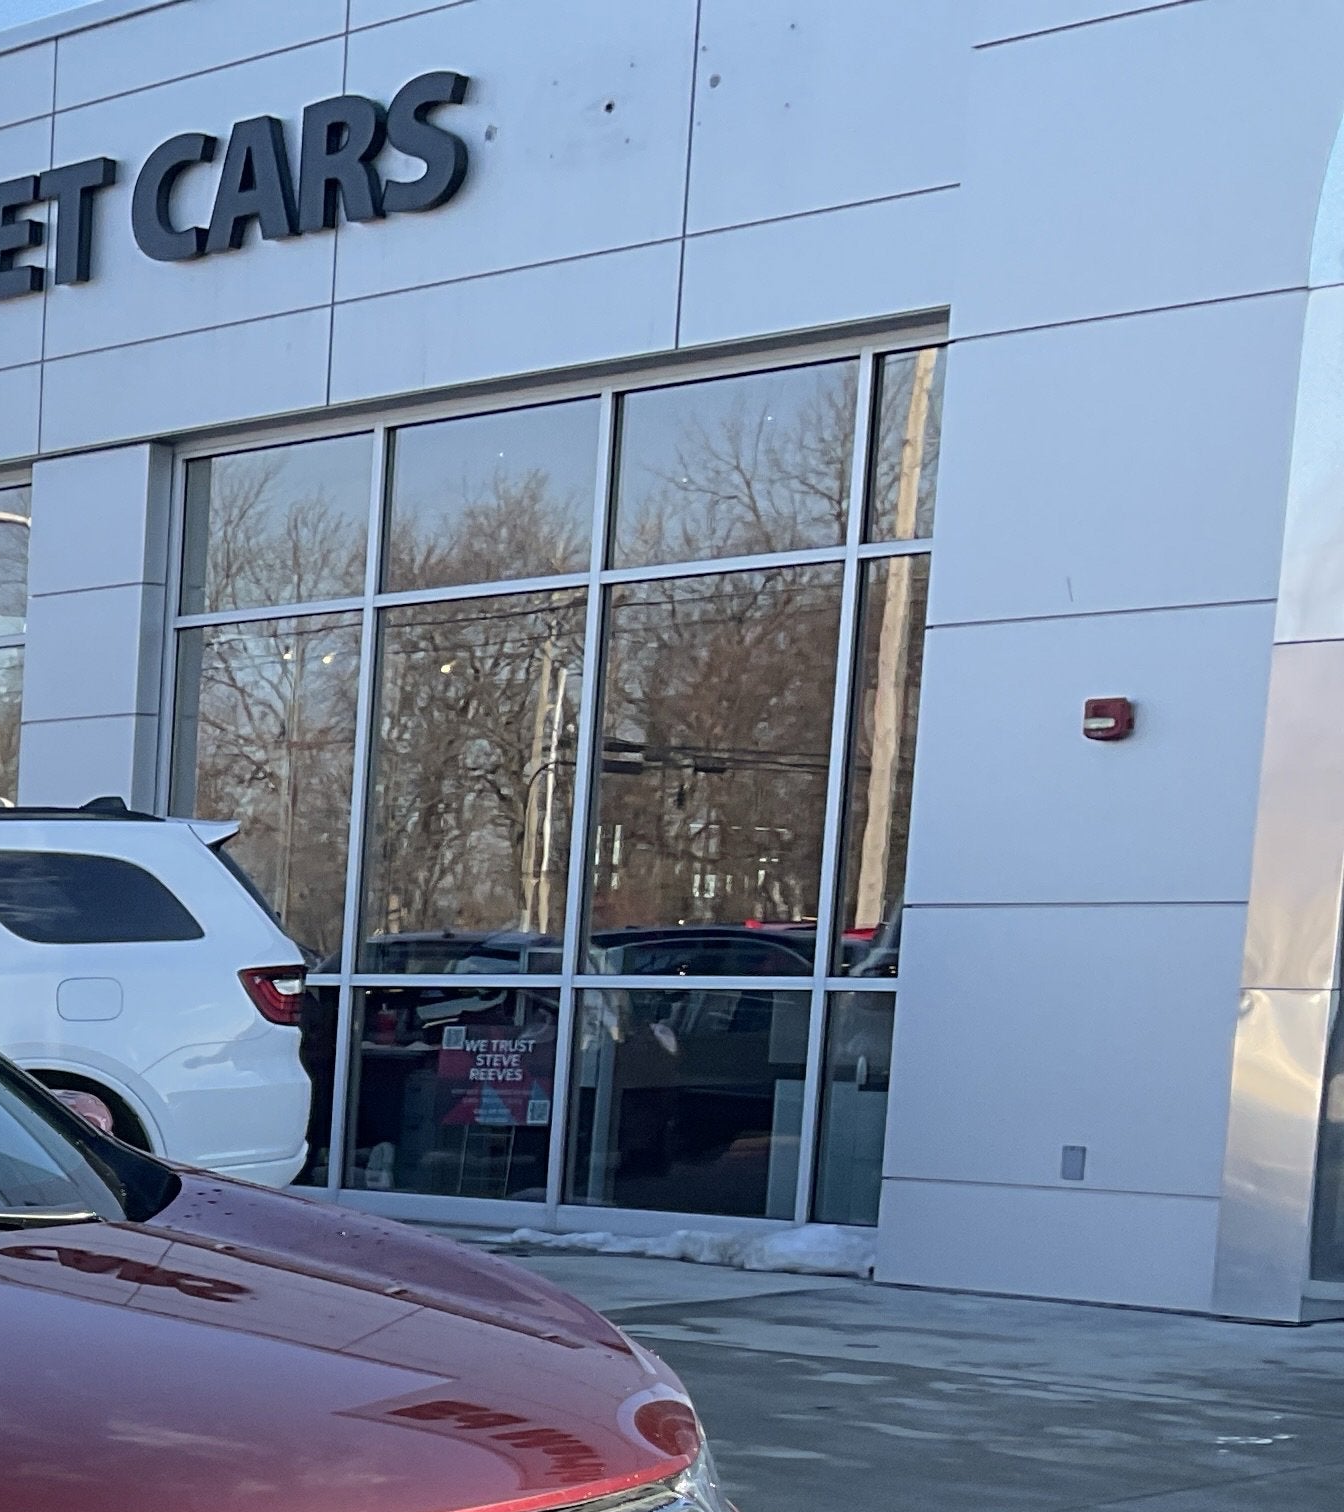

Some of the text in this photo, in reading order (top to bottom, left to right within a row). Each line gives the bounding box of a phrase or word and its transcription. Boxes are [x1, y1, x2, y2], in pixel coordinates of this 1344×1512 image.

[132, 71, 470, 263] CARS
[465, 1039, 535, 1053] WE TRUST
[476, 1054, 521, 1067] STEVE
[469, 1068, 523, 1081] REEVES
